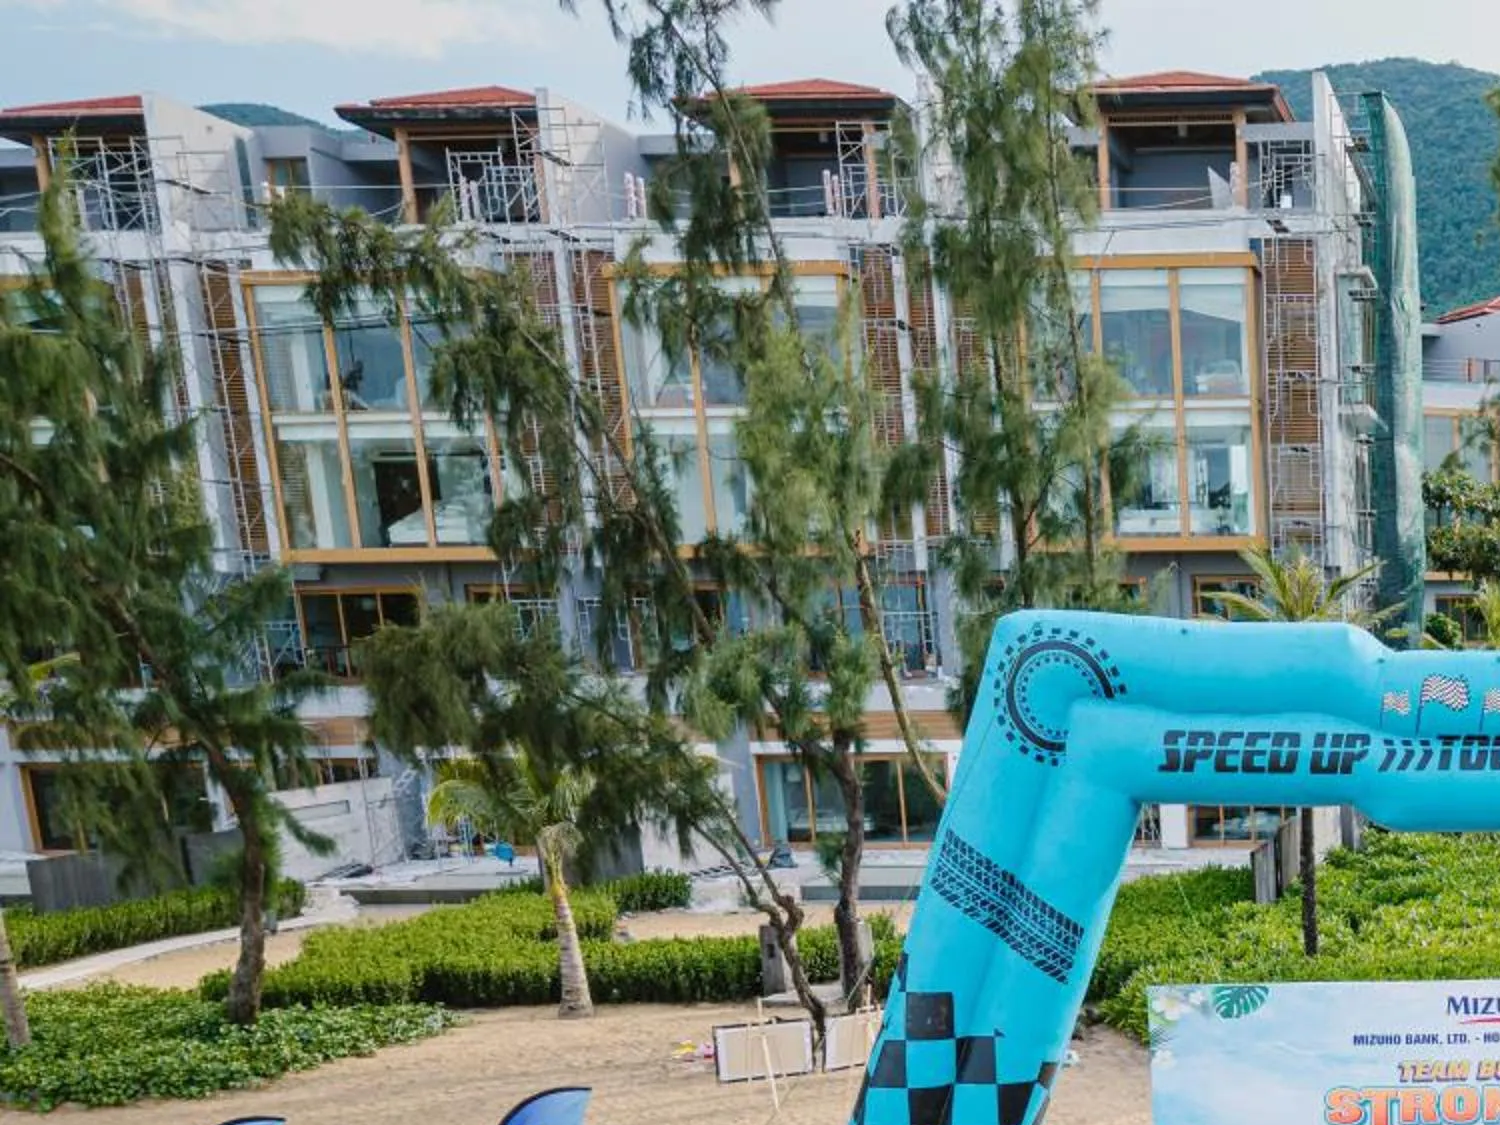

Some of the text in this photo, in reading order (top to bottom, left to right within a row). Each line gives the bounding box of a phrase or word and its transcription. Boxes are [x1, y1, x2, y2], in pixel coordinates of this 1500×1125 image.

[1158, 730, 1302, 774] SPEED
[1310, 732, 1370, 774] UP
[1352, 1033, 1402, 1046] MIZUHO
[1398, 1060, 1470, 1083] TEAM
